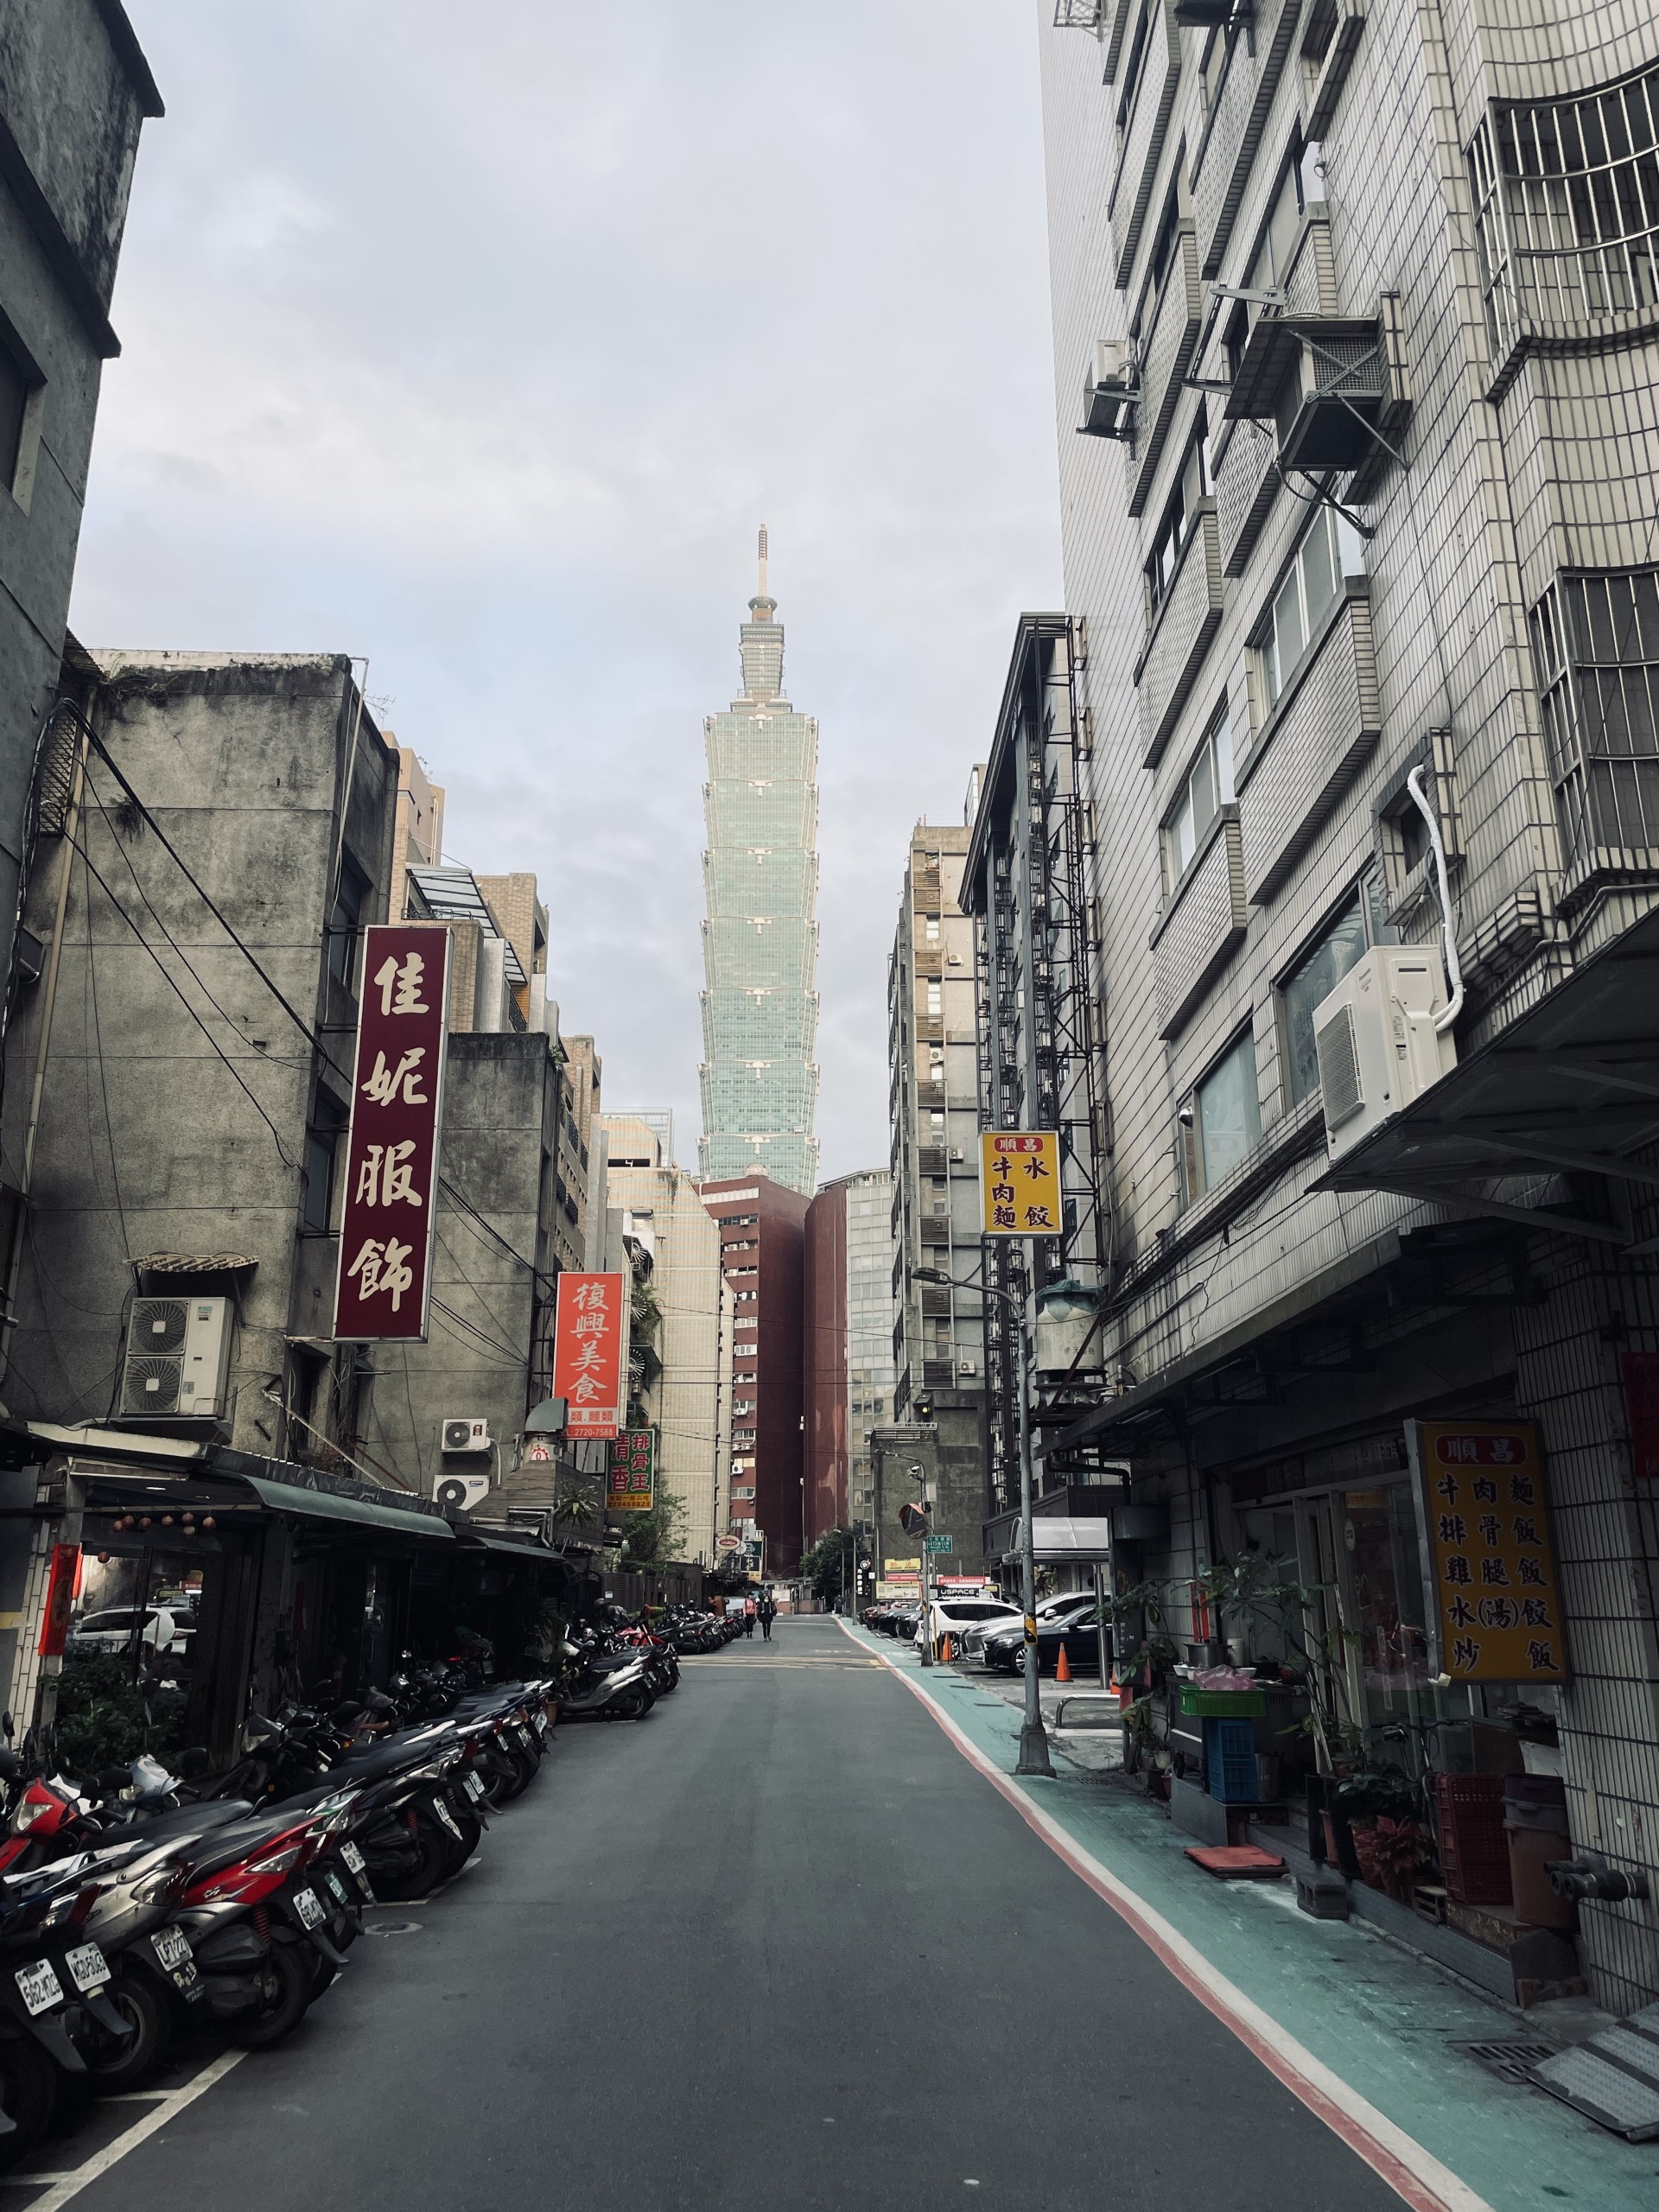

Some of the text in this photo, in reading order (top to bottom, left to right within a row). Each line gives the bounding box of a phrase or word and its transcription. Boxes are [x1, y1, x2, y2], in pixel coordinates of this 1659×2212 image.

[347, 952, 429, 1312] 佳妮服飾
[1000, 1138, 1037, 1152] 順昌
[991, 1155, 1017, 1229] 牛肉麵
[1022, 1156, 1054, 1228] 水餃
[569, 1282, 609, 1404] 復興美食
[611, 1432, 630, 1492] 清香
[630, 1433, 650, 1491] 排骨王
[1446, 1437, 1514, 1464] 順昌
[1436, 1472, 1535, 1507] 牛肉麵
[1438, 1514, 1544, 1548] 排骨飯
[1443, 1555, 1549, 1588] 雞腿飯
[1446, 1595, 1554, 1630] 水(湯)餃
[1452, 1636, 1560, 1673] 炒飯
